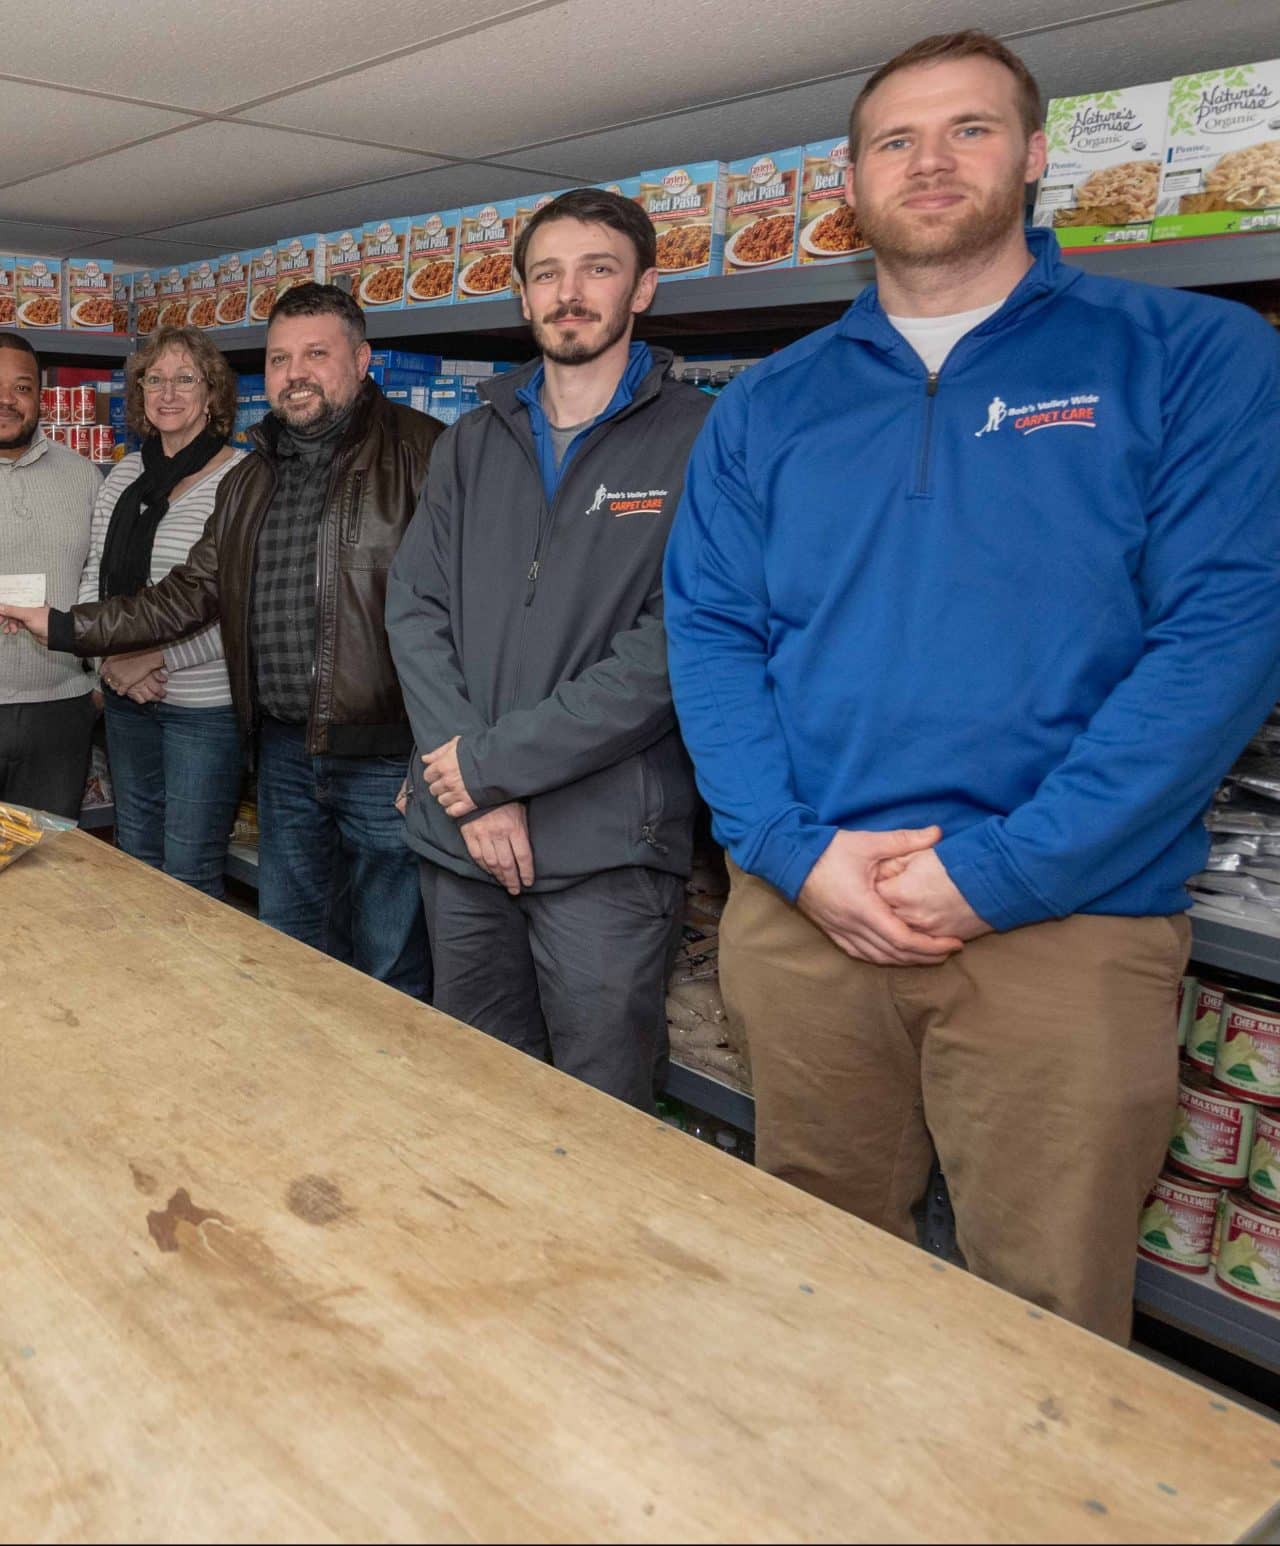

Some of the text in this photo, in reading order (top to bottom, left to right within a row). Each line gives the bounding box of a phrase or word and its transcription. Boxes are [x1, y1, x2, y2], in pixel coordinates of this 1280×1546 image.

[1203, 83, 1272, 105] Nature's
[1076, 107, 1136, 125] Nature's
[1194, 99, 1280, 125] Promise
[1205, 112, 1256, 129] Organic
[1069, 120, 1143, 144] Promise
[1077, 135, 1122, 148] Organic
[815, 174, 839, 190] Beef
[736, 183, 785, 204] Beef Pasta
[649, 194, 701, 212] Beef Pasta
[1008, 394, 1099, 416] Bob's Valley Wide
[1014, 407, 1095, 429] CARPET CARE
[627, 491, 648, 499] Valley
[649, 489, 668, 497] Wide
[609, 499, 664, 511] CARPET CARE
[1203, 995, 1221, 1006] CHEF
[1234, 1016, 1257, 1029] CHEF
[1190, 1095, 1236, 1119] MAXWELL
[1173, 1192, 1214, 1210] MAXWELL
[1236, 1215, 1258, 1230] CHEF
